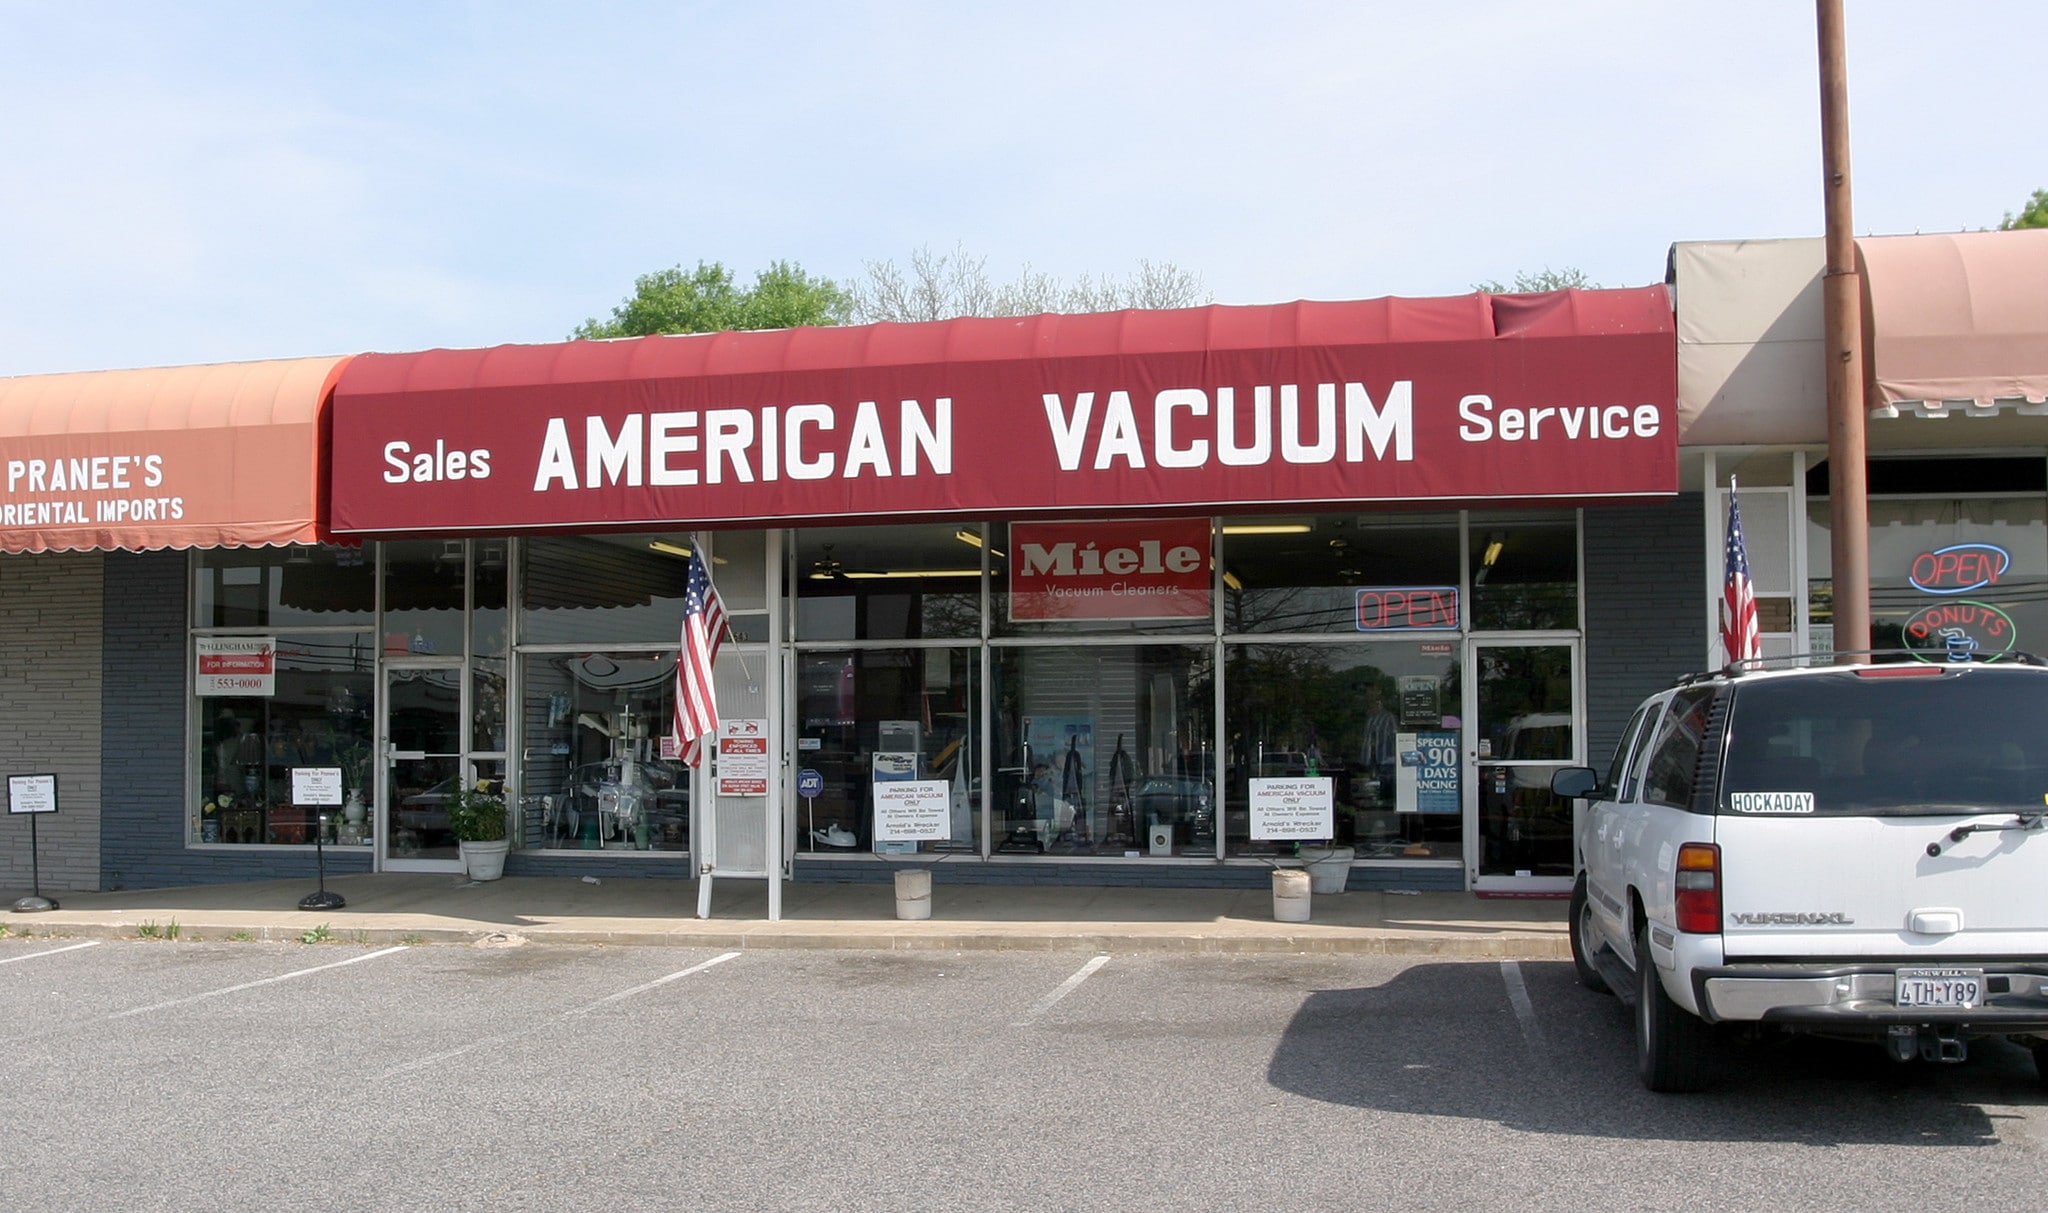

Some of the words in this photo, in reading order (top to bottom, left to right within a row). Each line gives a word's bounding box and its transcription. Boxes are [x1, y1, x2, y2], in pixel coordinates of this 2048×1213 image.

[383, 438, 492, 484] Sales
[533, 397, 953, 492] AMERICAN
[1042, 380, 1414, 471] VACUUM
[1459, 394, 1660, 442] Service
[8, 455, 163, 492] PRANEE'S
[97, 497, 184, 522] IMPORTS
[1020, 540, 1201, 576] Miele
[1911, 552, 2002, 585] OPEN
[1046, 583, 1103, 597] Vacuum
[1111, 581, 1178, 597] Cleaners
[1360, 591, 1456, 628] OPEN
[1908, 606, 2008, 639] DONUTS
[206, 660, 220, 668] FOR
[222, 660, 265, 669] INFORMATION
[217, 678, 262, 689] 553-0000
[1417, 737, 1456, 747] SPECIAL
[1428, 748, 1457, 767] 90
[1424, 767, 1457, 779] DAYS
[801, 778, 819, 788] ADT
[1732, 794, 1812, 812] HOCKADAY
[1917, 969, 1961, 977] SEWELL
